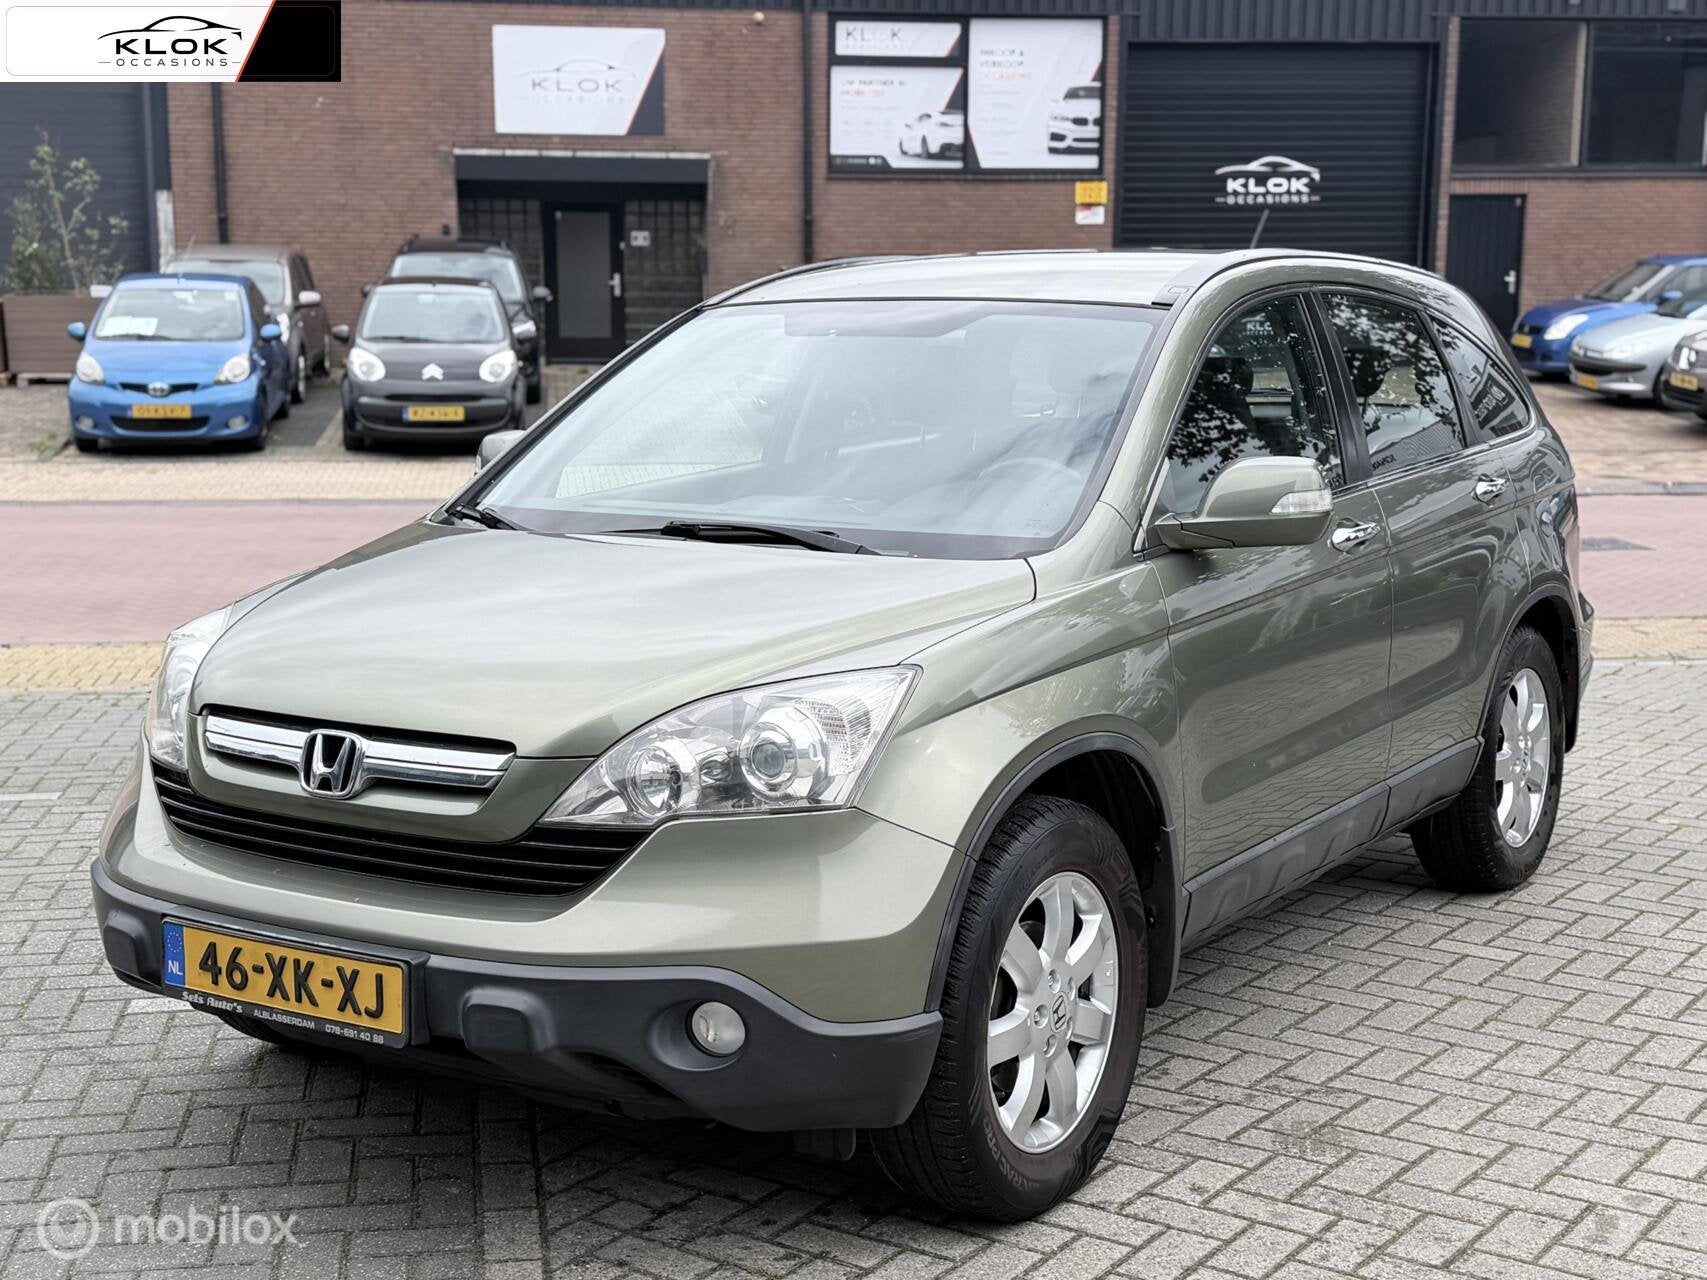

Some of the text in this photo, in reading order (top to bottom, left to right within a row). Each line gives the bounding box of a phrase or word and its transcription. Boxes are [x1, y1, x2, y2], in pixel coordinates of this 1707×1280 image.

[845, 26, 903, 42] KLK
[531, 78, 624, 93] KLOK
[1226, 177, 1310, 193] KLOK
[1226, 194, 1309, 204] OCCASIONS
[168, 960, 183, 976] NL
[198, 941, 385, 1019] 46-XK-XJ
[207, 997, 243, 1013] Auto's
[254, 1009, 315, 1029] ALBLASSERDAM
[359, 1032, 371, 1041] 40
